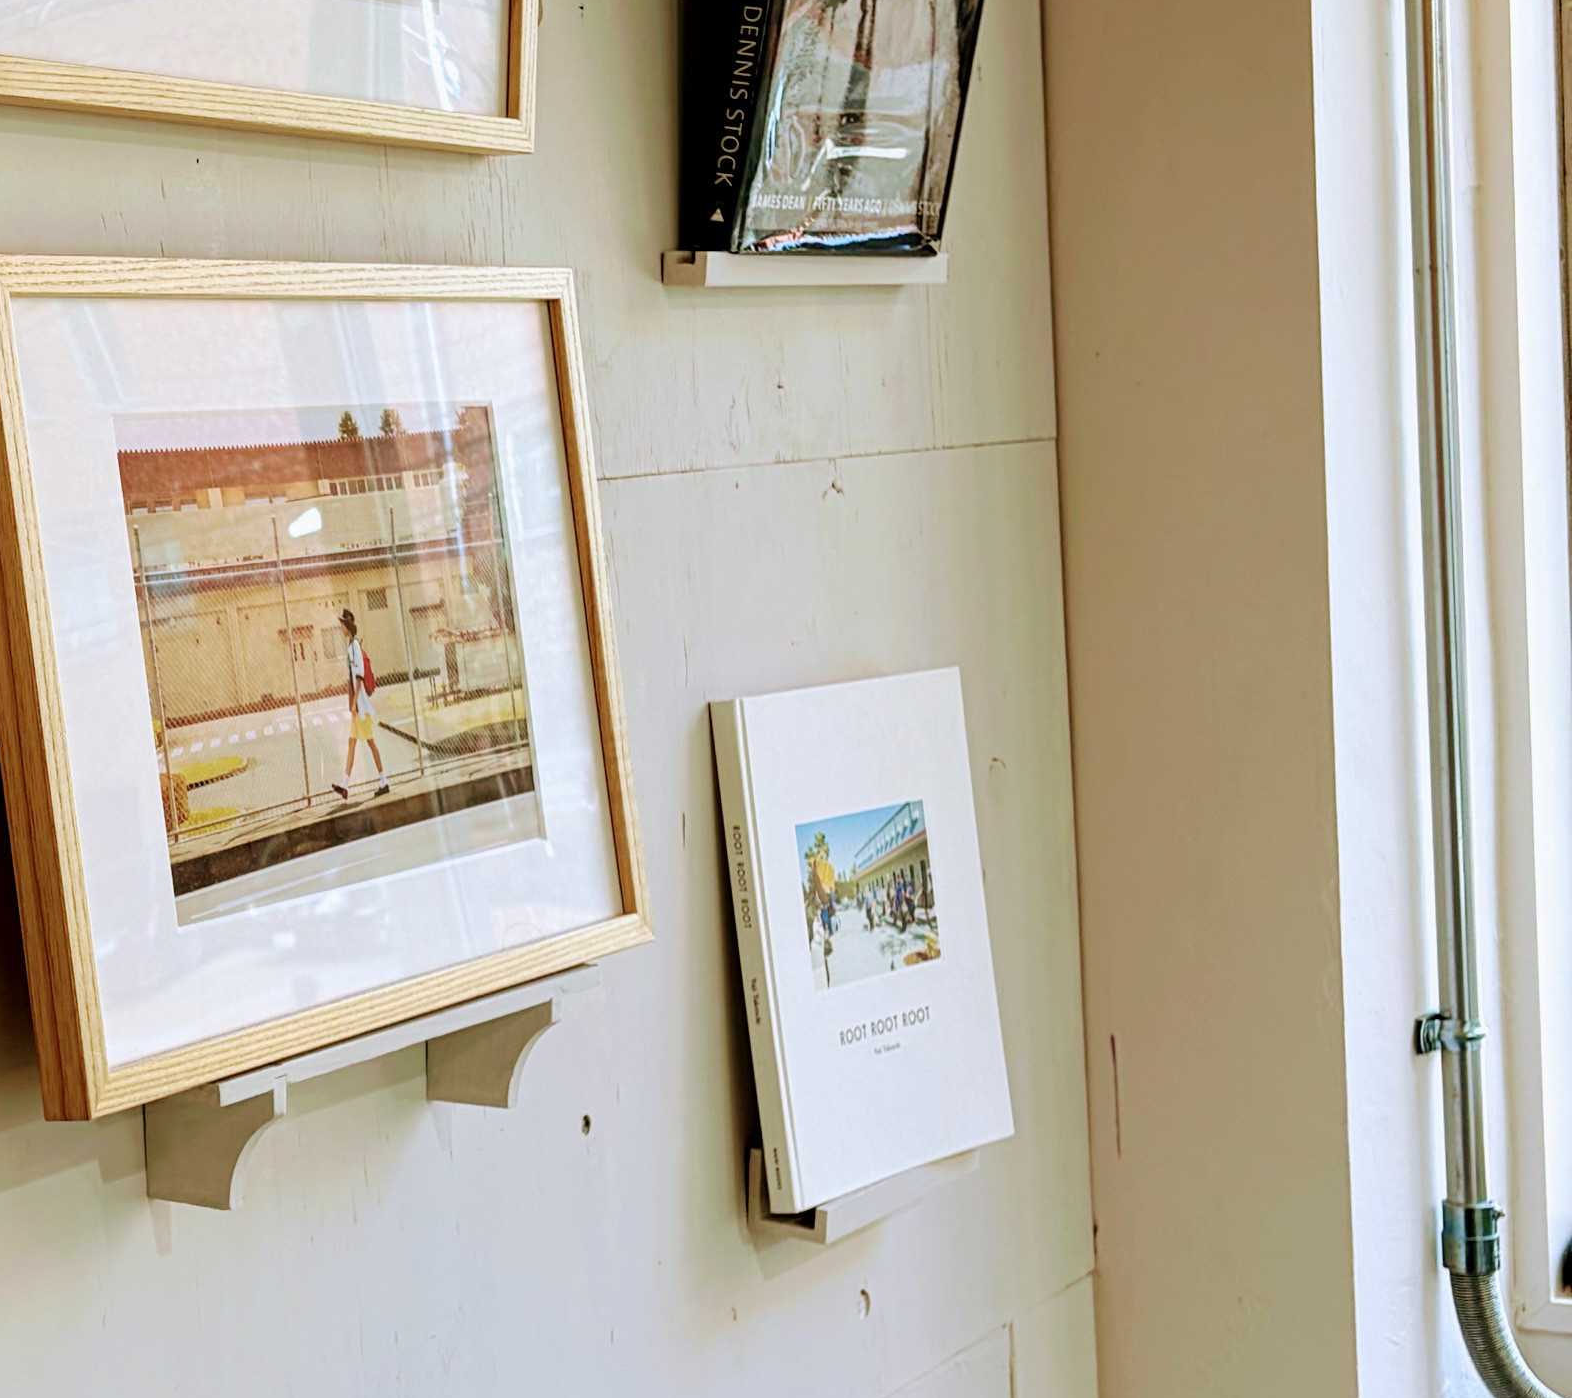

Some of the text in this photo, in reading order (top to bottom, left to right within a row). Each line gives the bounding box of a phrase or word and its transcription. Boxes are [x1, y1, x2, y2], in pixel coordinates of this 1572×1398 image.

[728, 6, 763, 100] DENNIS
[714, 109, 745, 187] STOCK
[782, 194, 806, 210] DEAN
[733, 826, 752, 929] ROOT ROOT ROOT
[839, 1006, 930, 1046] ROOT ROOT ROOT
